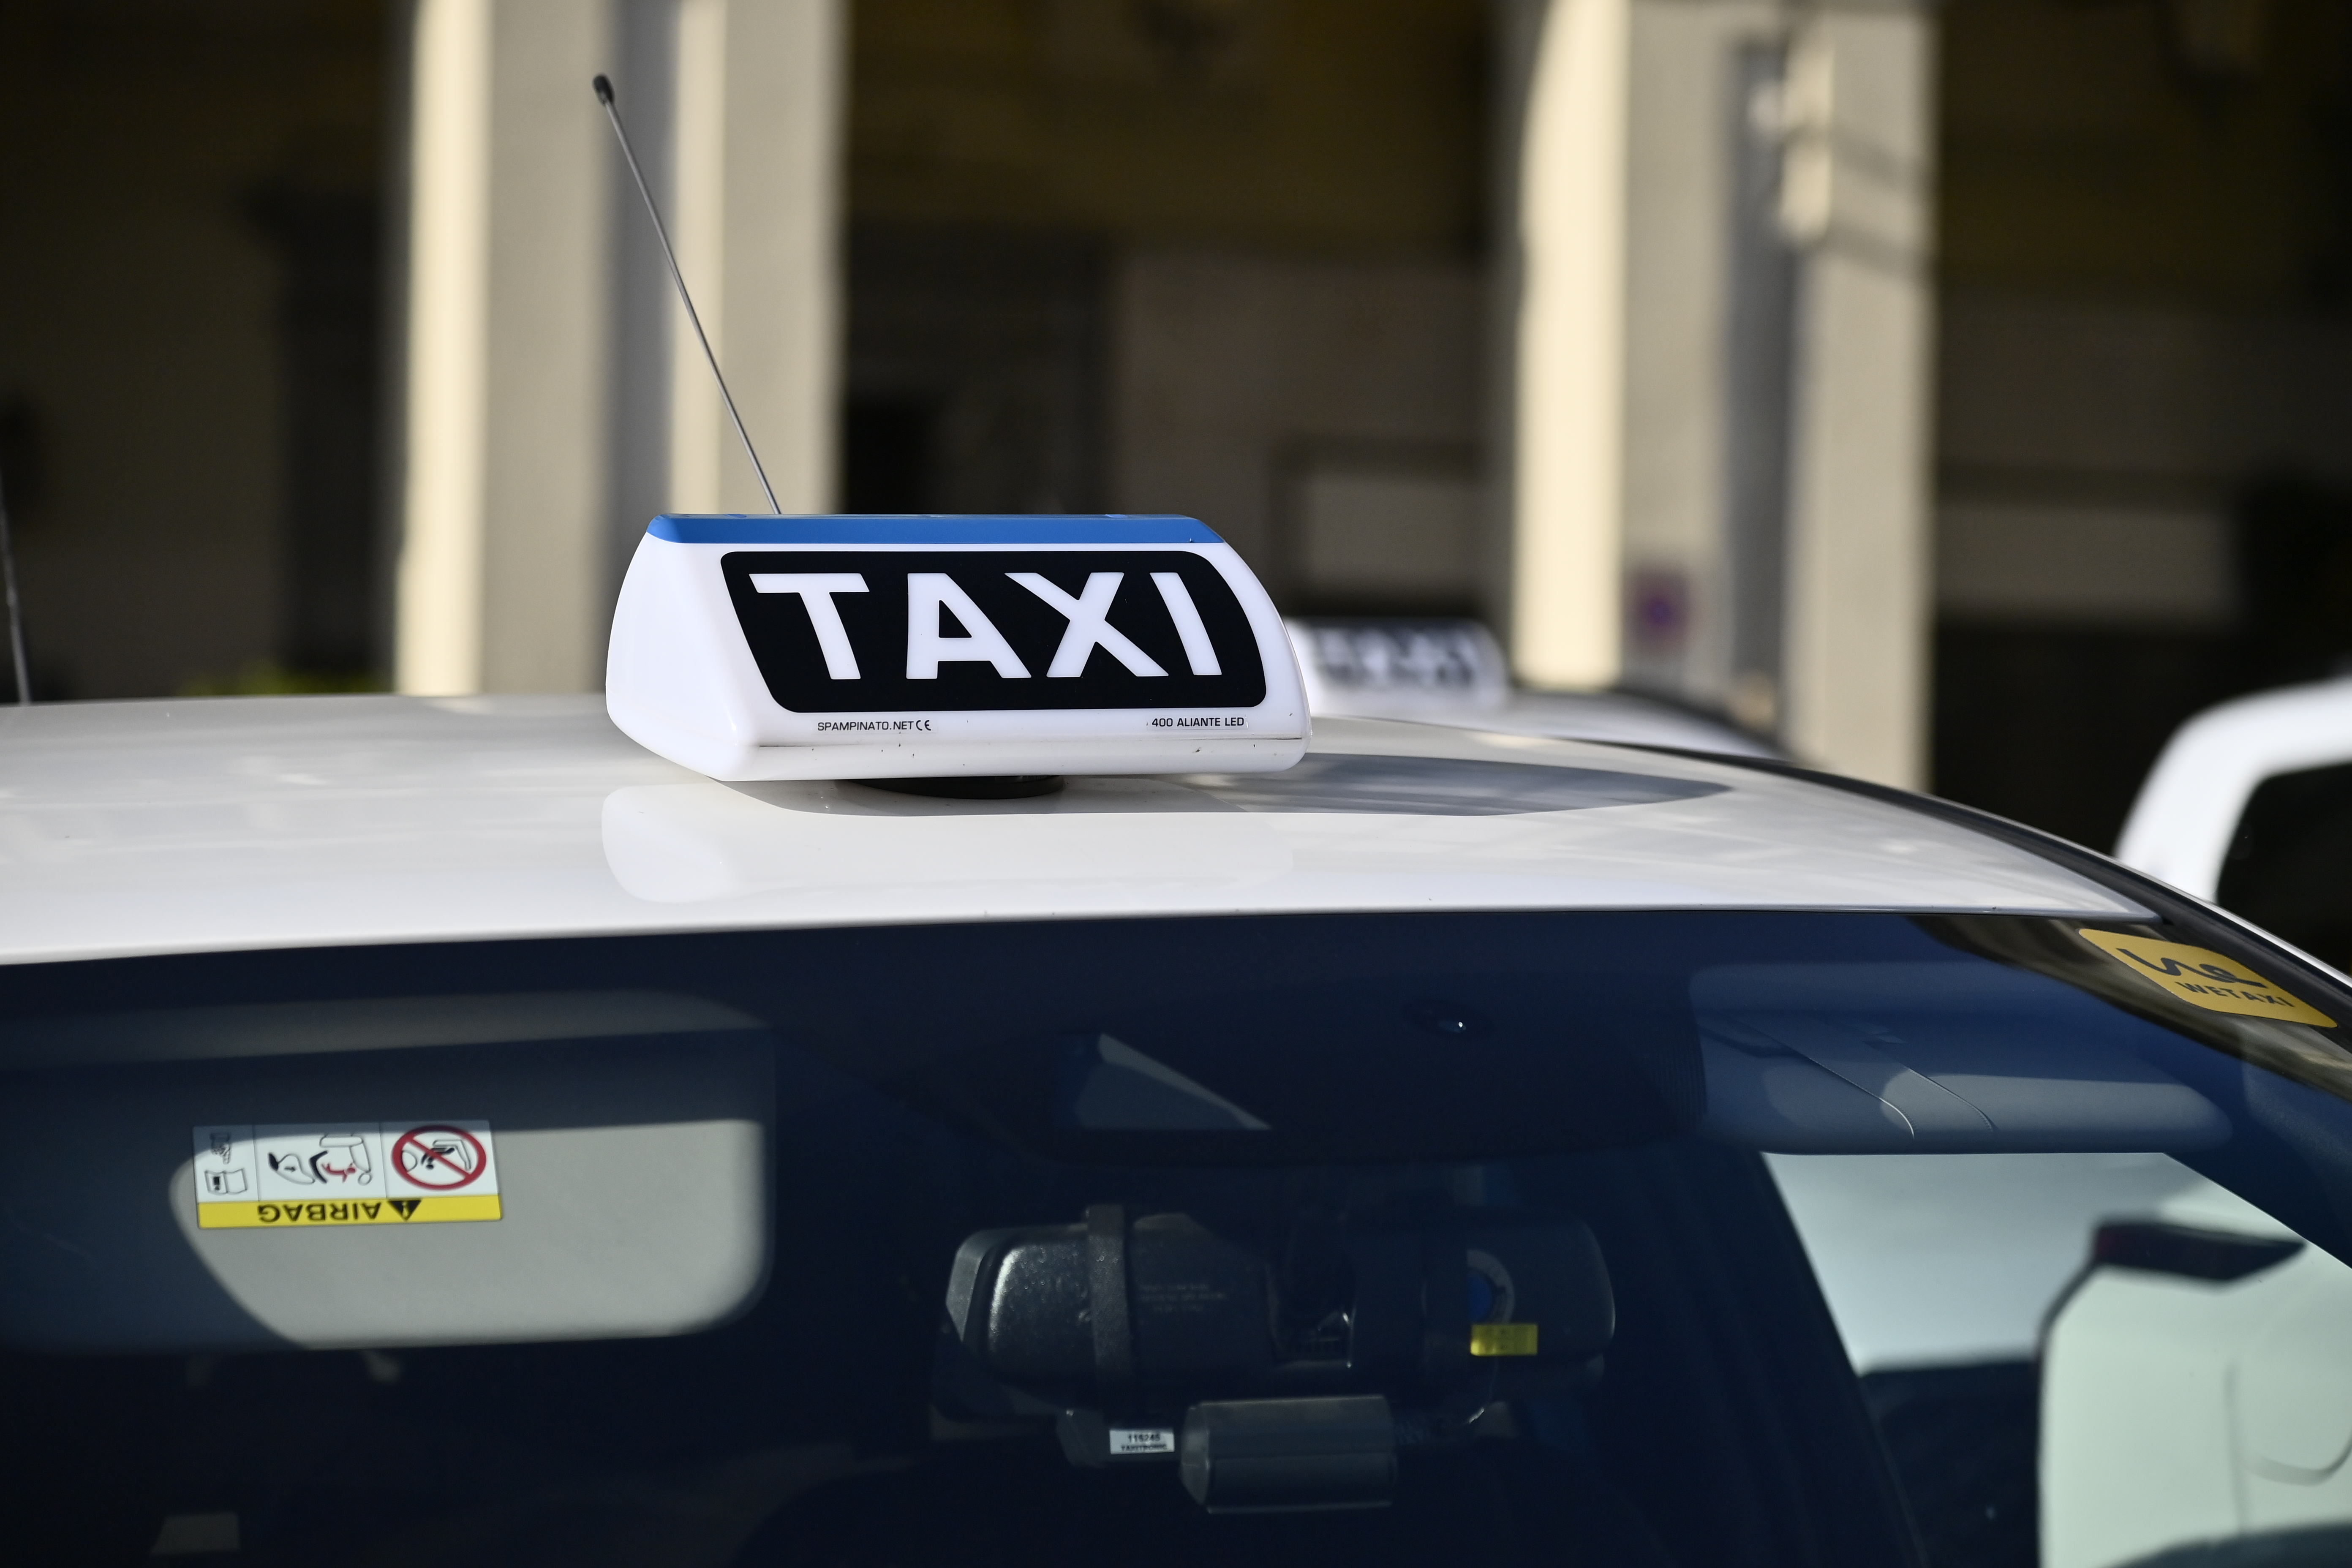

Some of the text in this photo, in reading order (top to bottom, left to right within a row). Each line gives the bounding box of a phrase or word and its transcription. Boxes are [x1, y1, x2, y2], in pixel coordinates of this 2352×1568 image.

[749, 572, 1222, 680] TAXI
[818, 721, 914, 731] SPAMPINATO.NET
[1152, 717, 1244, 727] 400 ALIANTE LED
[2175, 982, 2295, 1008] WETAXI
[257, 1202, 381, 1222] AIRBAG
